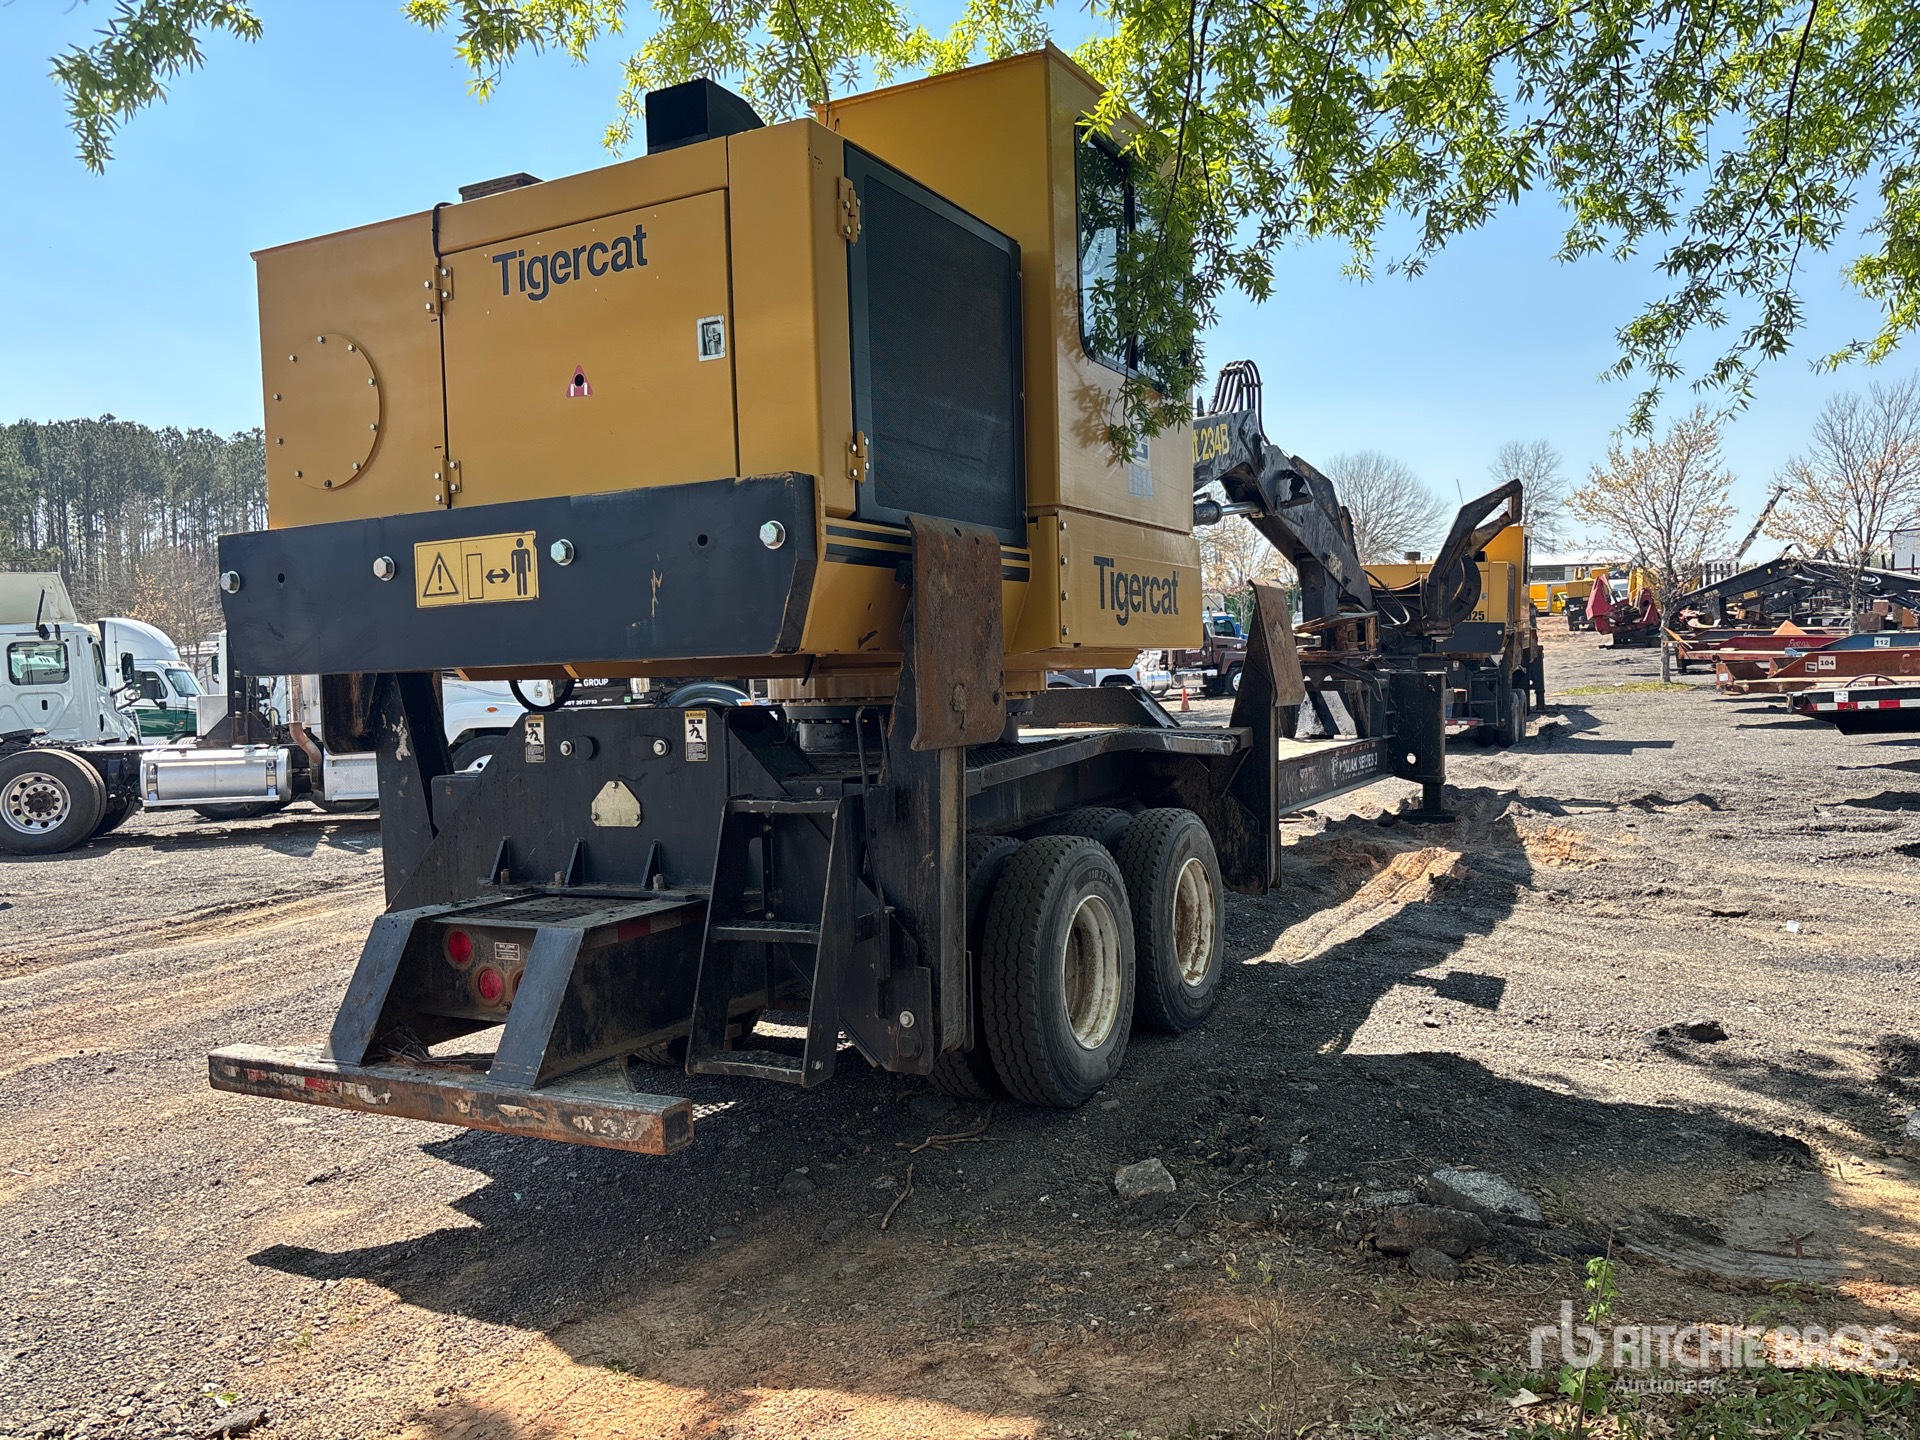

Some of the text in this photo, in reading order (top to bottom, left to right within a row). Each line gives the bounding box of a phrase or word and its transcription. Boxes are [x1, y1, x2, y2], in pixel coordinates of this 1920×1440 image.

[492, 224, 648, 301] Tigercat
[1201, 423, 1230, 461] 234B
[1093, 555, 1179, 626] Tigercat
[583, 678, 609, 687] GROUP
